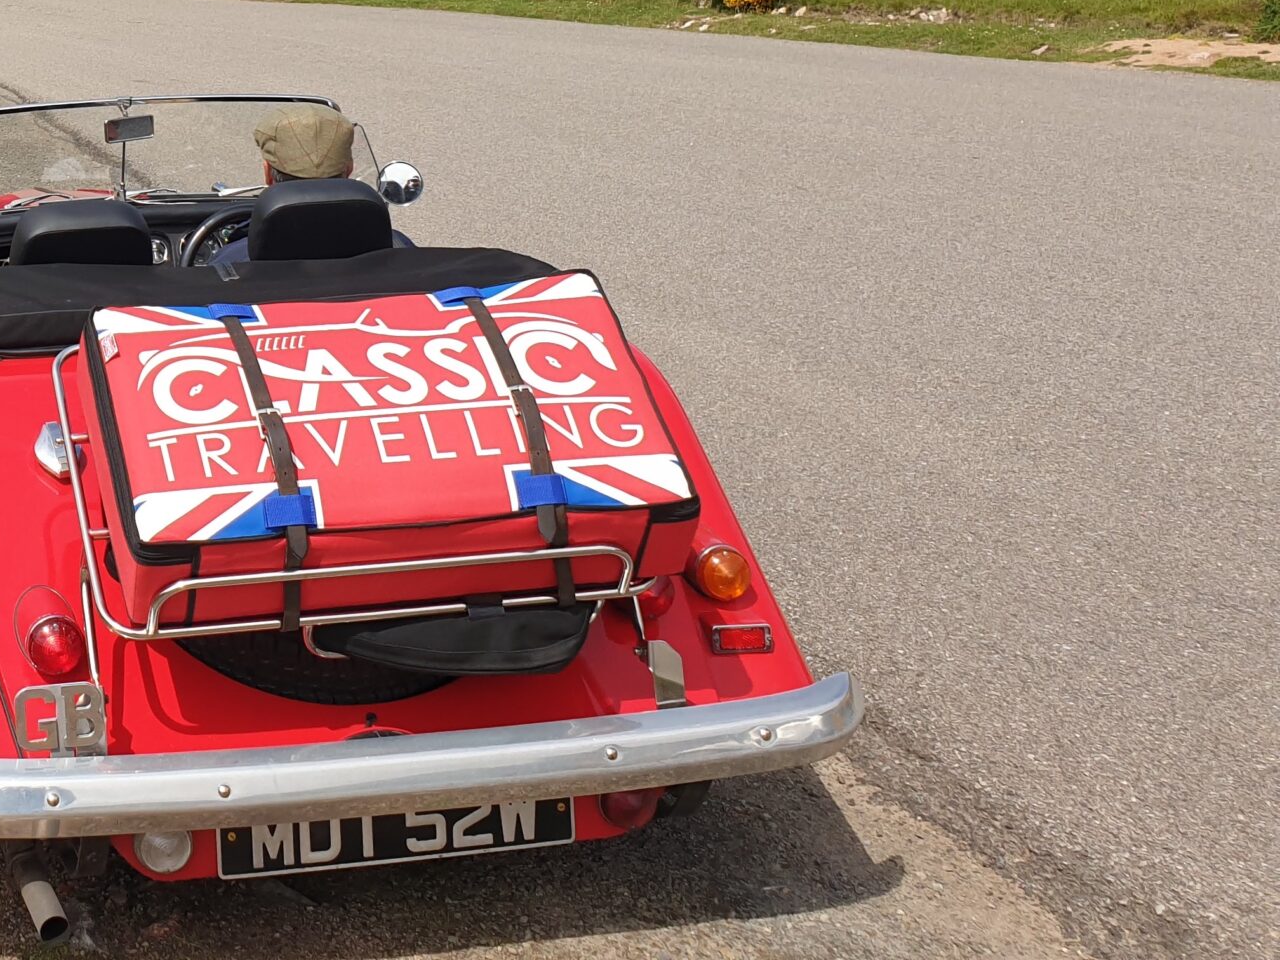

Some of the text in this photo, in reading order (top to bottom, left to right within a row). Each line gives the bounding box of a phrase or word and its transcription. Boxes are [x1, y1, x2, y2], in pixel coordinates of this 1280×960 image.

[153, 330, 596, 425] CLASSIC
[149, 403, 644, 482] TRAVELLING
[14, 682, 105, 751] GB
[405, 800, 536, 852] 52W
